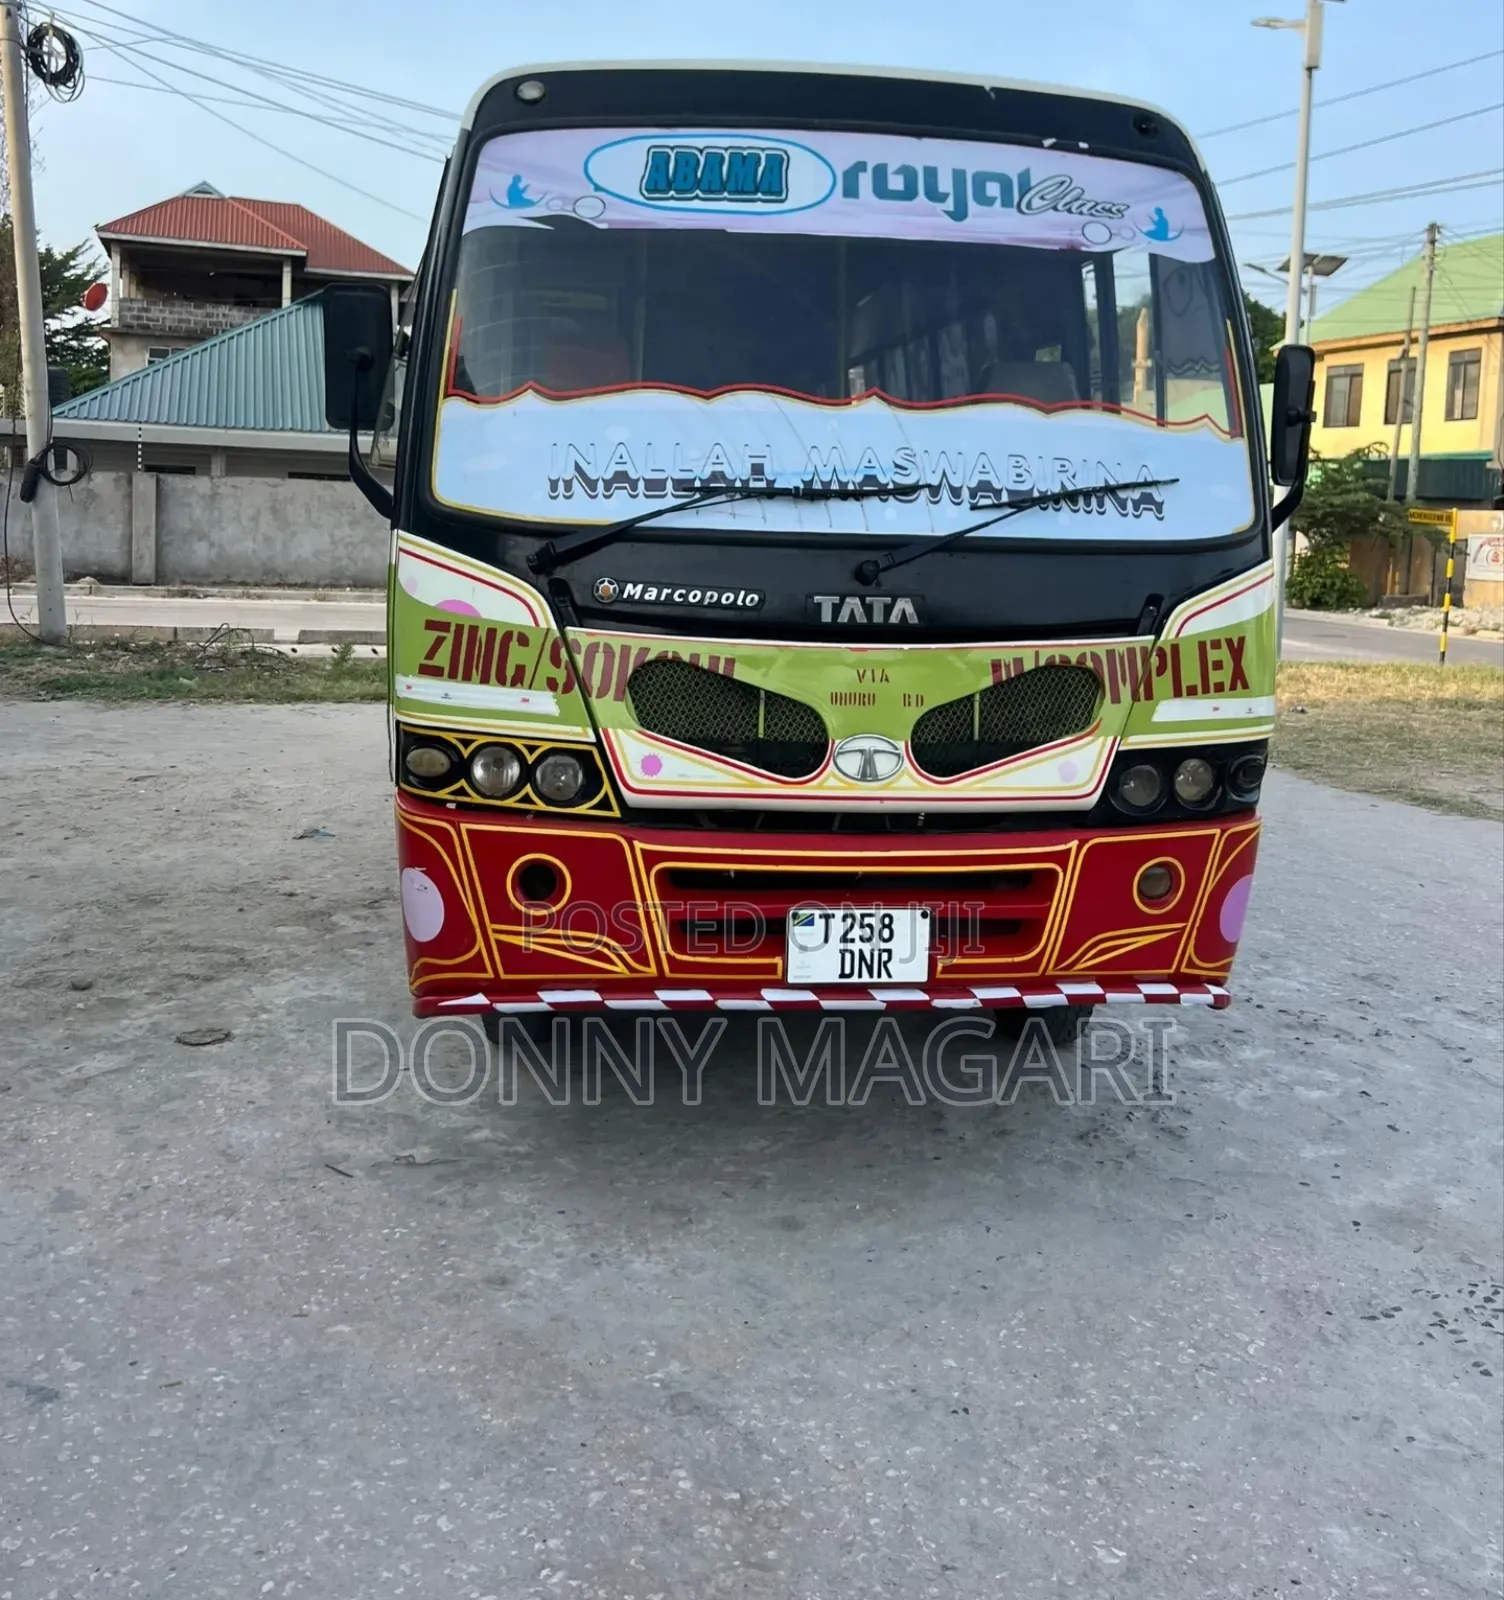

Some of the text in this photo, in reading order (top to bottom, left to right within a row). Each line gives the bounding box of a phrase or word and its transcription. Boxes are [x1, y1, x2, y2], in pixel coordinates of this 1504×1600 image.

[640, 145, 789, 203] ABAMA
[842, 161, 1130, 222] royal Class
[547, 440, 776, 499] INALLAH
[622, 582, 760, 607] Marcopolo
[813, 595, 920, 625] TATA
[856, 668, 890, 684] VIA
[819, 912, 895, 944] T 258
[838, 948, 893, 979] DNR
